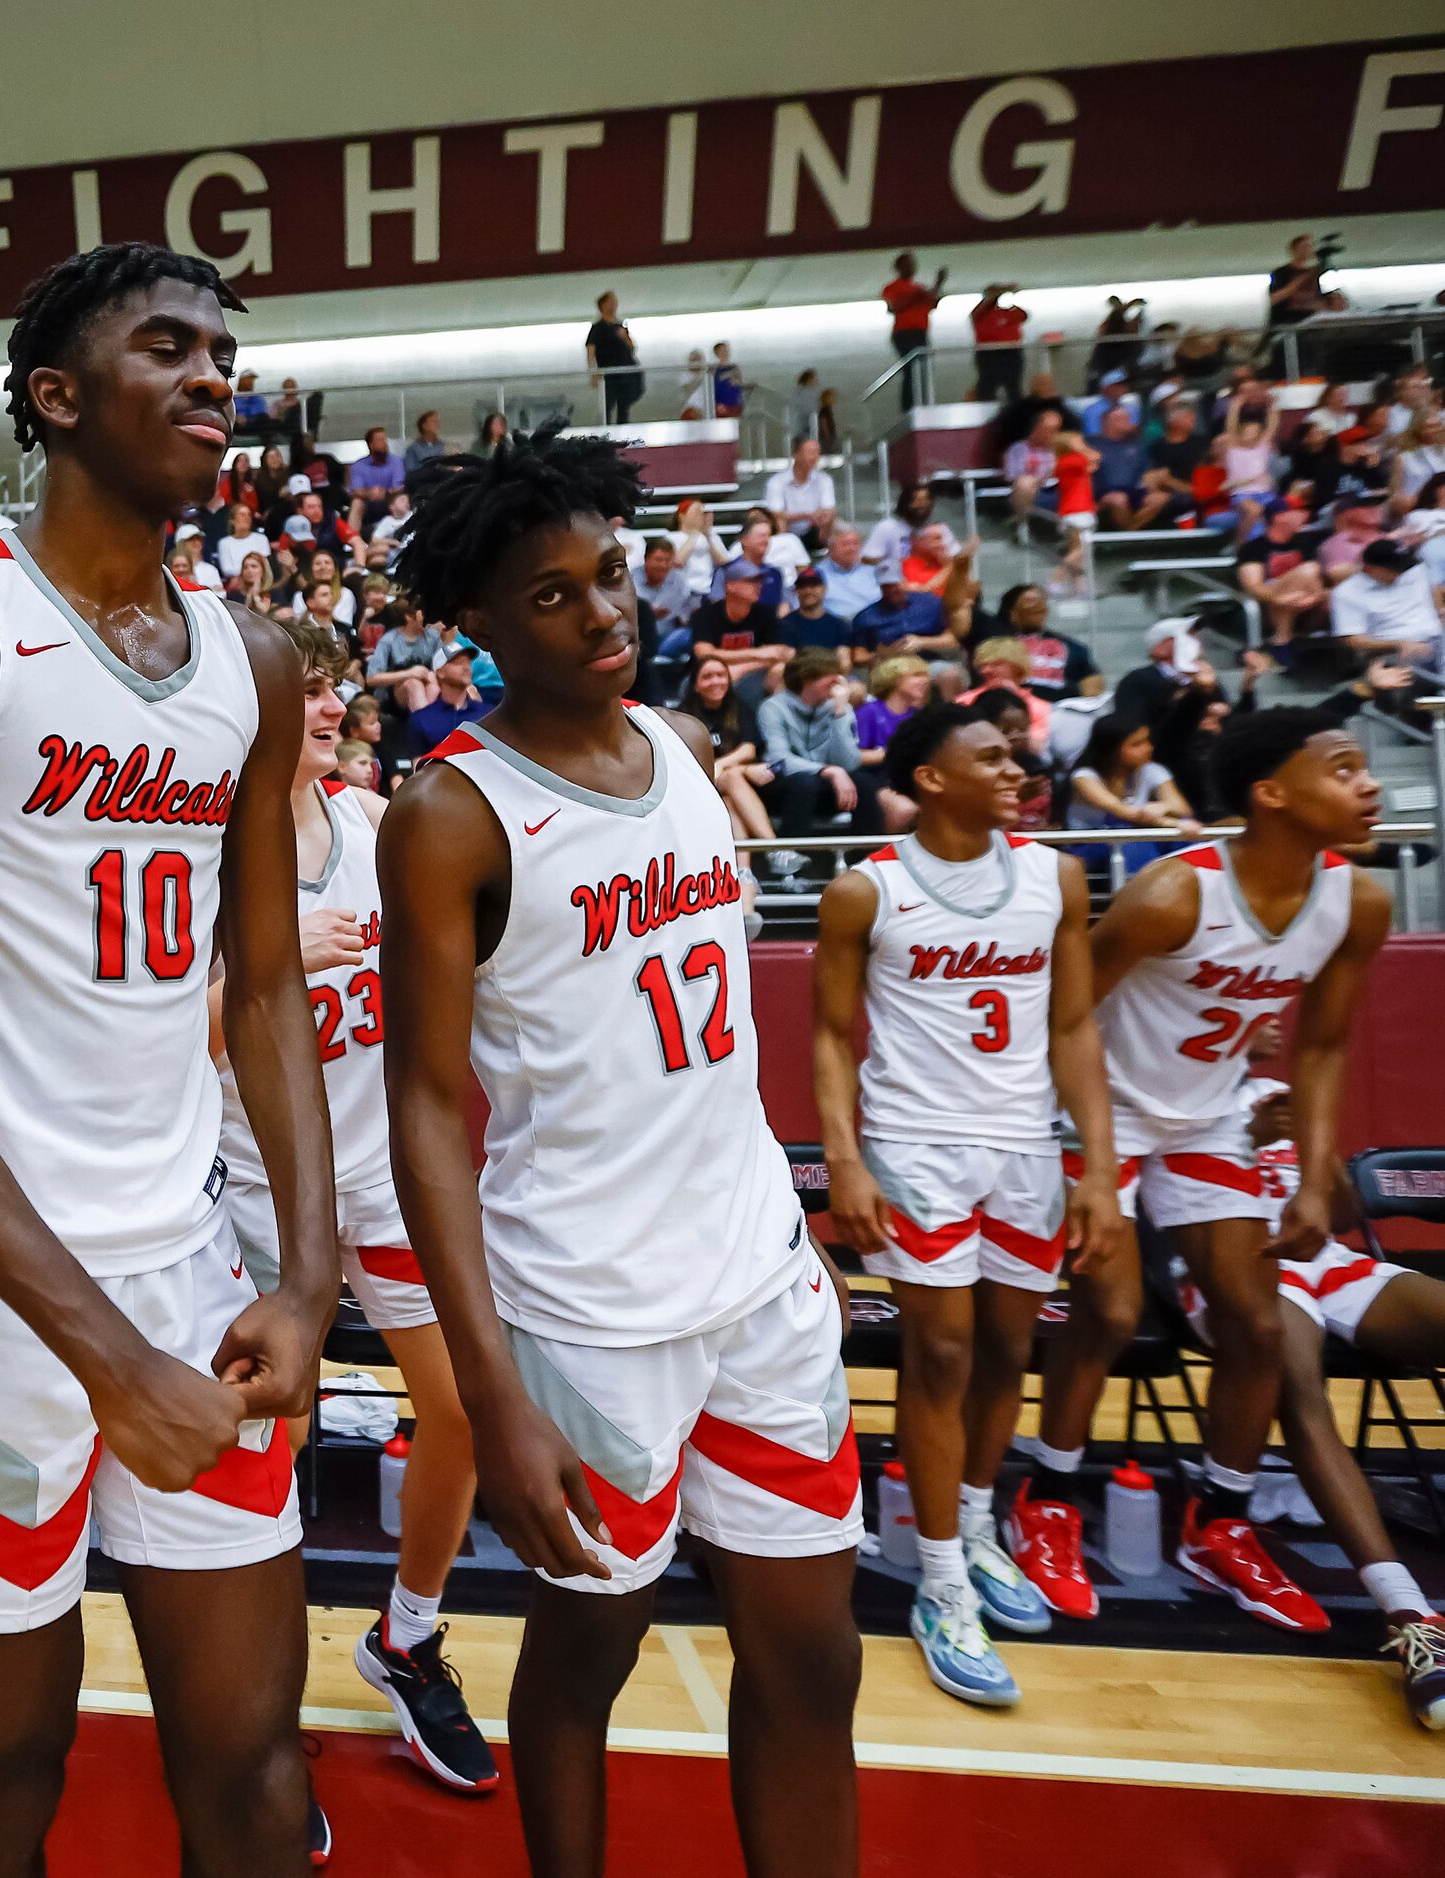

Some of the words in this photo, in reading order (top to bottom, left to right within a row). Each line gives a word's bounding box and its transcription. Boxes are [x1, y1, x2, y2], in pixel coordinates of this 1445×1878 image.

[85, 846, 195, 984] 10
[570, 851, 741, 957] Wildcats
[632, 937, 736, 1077] 12
[908, 941, 1049, 981] Wildcats
[308, 967, 385, 1064] 23
[968, 988, 1011, 1054] 3
